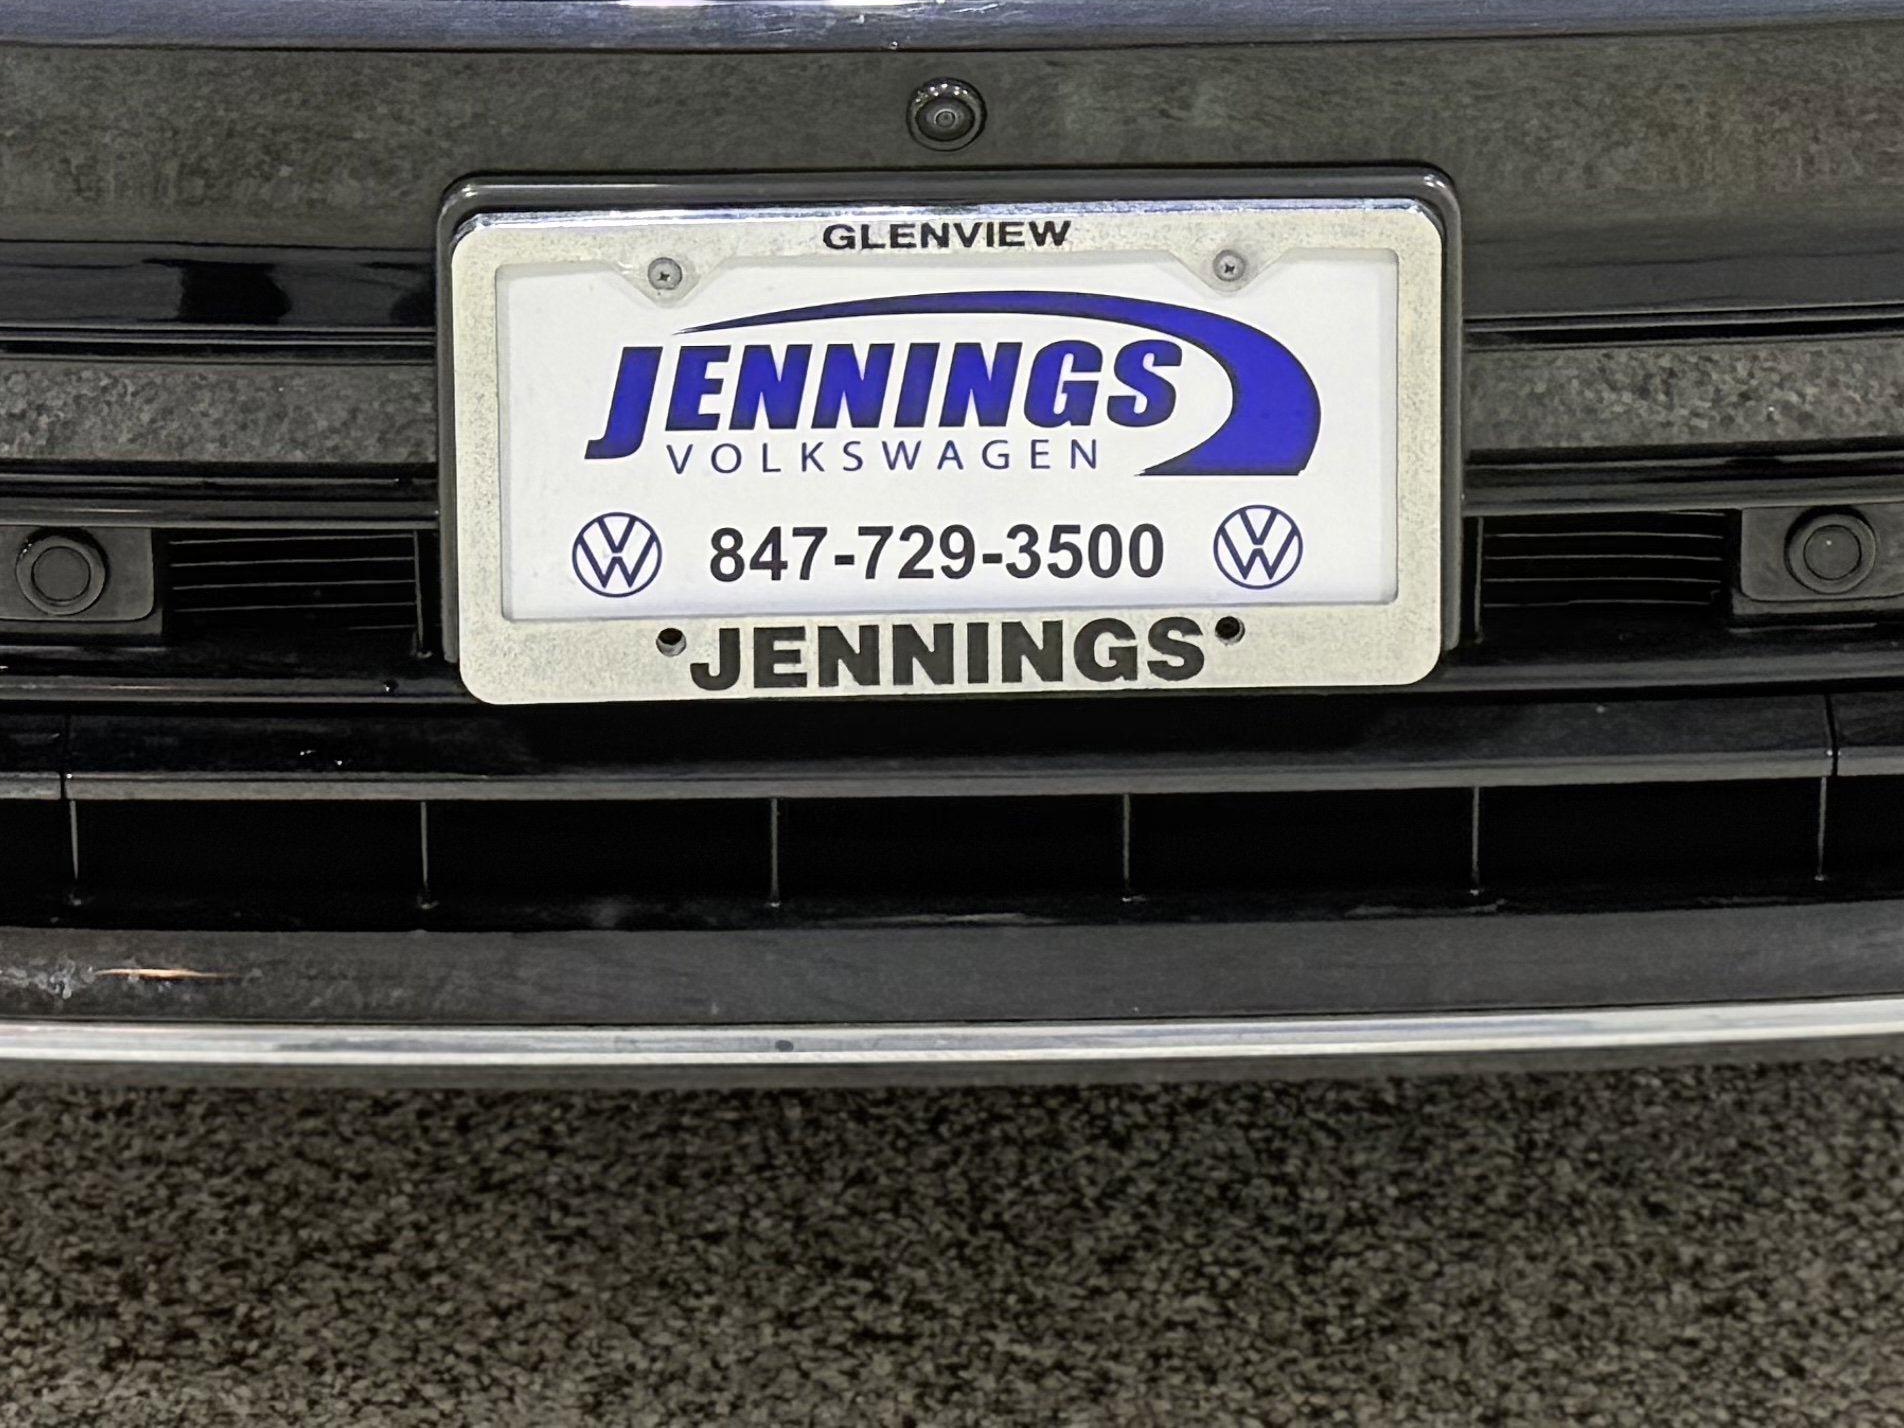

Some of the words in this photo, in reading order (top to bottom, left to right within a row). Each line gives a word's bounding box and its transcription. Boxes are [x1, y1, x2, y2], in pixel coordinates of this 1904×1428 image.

[821, 219, 1072, 251] GLENVIEW
[583, 339, 1184, 461] JENNINGS
[666, 438, 1098, 475] VOLKSWAGEN
[708, 522, 1164, 584] 847-729-3500
[690, 616, 1206, 692] JENNINGS
